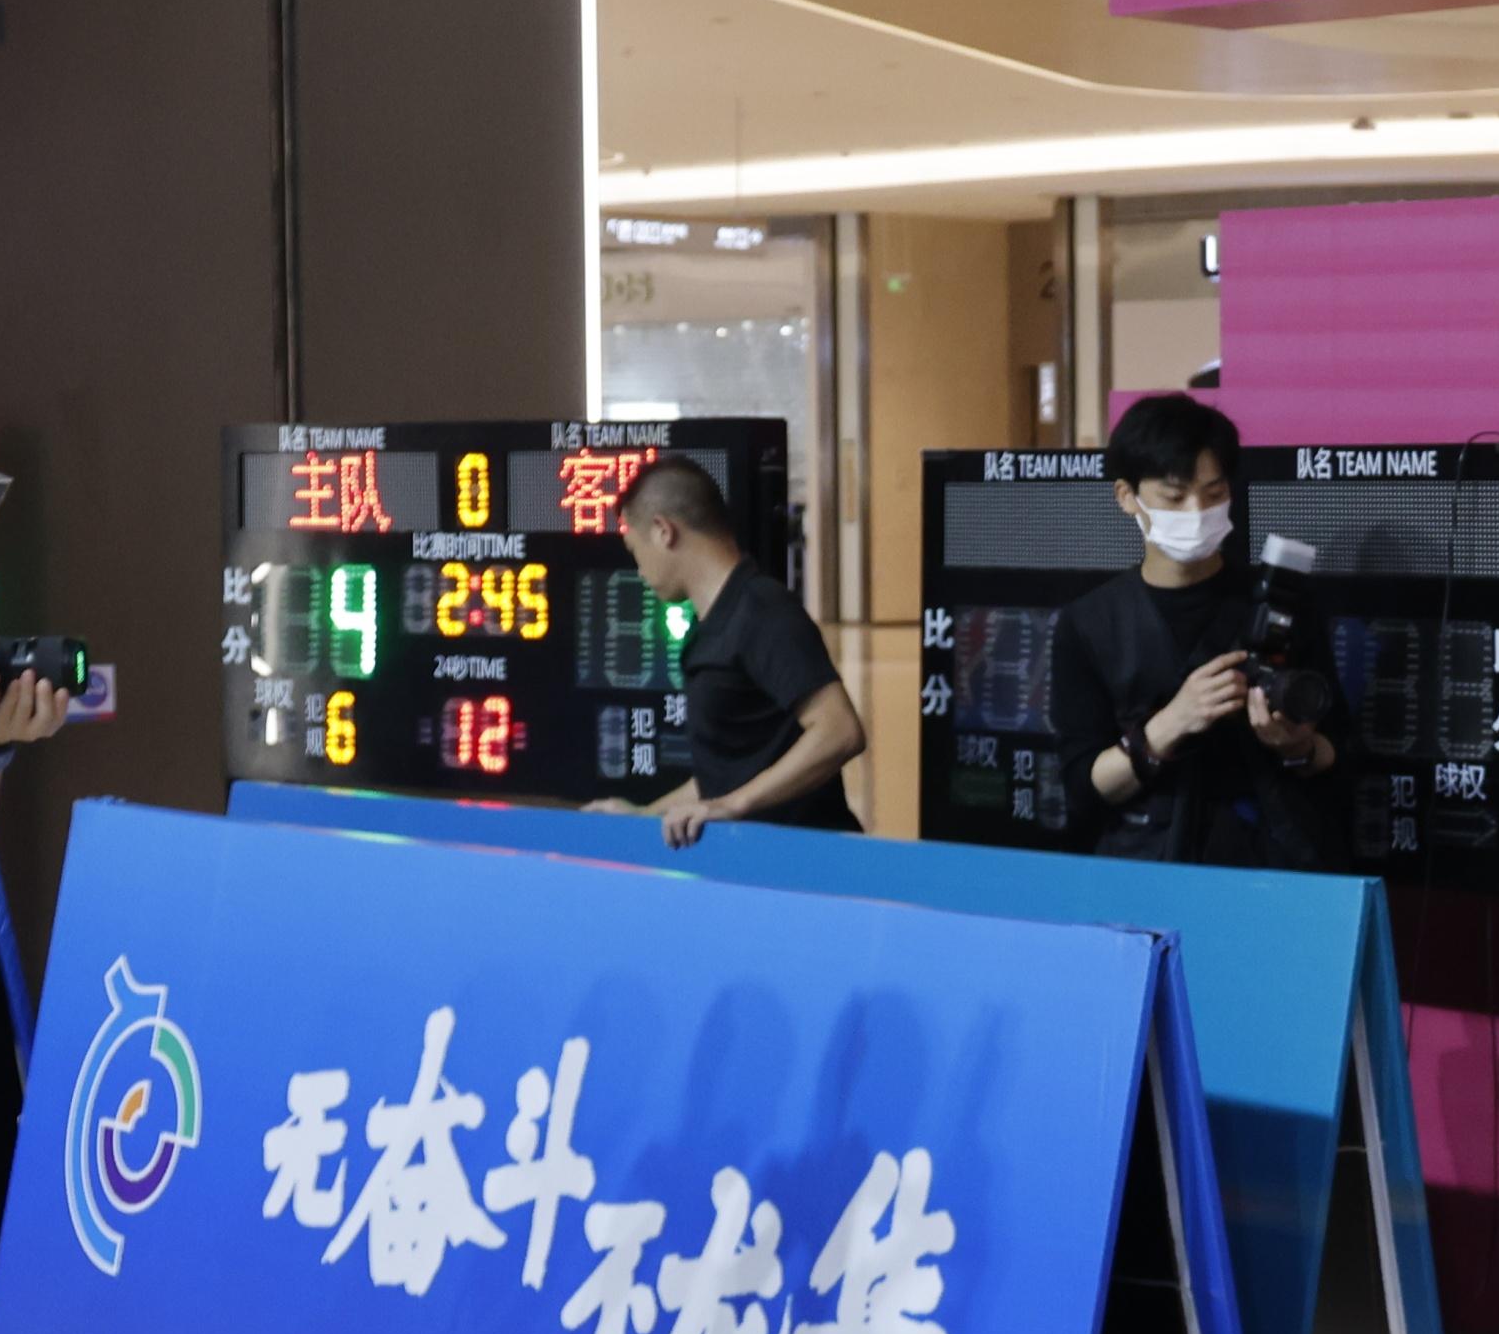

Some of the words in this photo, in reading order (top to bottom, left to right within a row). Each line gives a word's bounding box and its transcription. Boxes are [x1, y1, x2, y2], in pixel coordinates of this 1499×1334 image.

[309, 428, 344, 450] TEAM
[346, 427, 387, 449] NAME
[584, 424, 623, 447] TEAM
[627, 423, 671, 446] NAME
[457, 452, 489, 528] 0
[984, 451, 1014, 481] 队名
[1018, 454, 1057, 478] TEAM
[1059, 454, 1105, 478] NAME
[1296, 448, 1332, 479] 队名
[1337, 451, 1382, 476] TEAM
[1387, 450, 1438, 476] NAME
[289, 450, 393, 533] 主队
[437, 562, 549, 639] 2:45
[325, 690, 356, 765] 6
